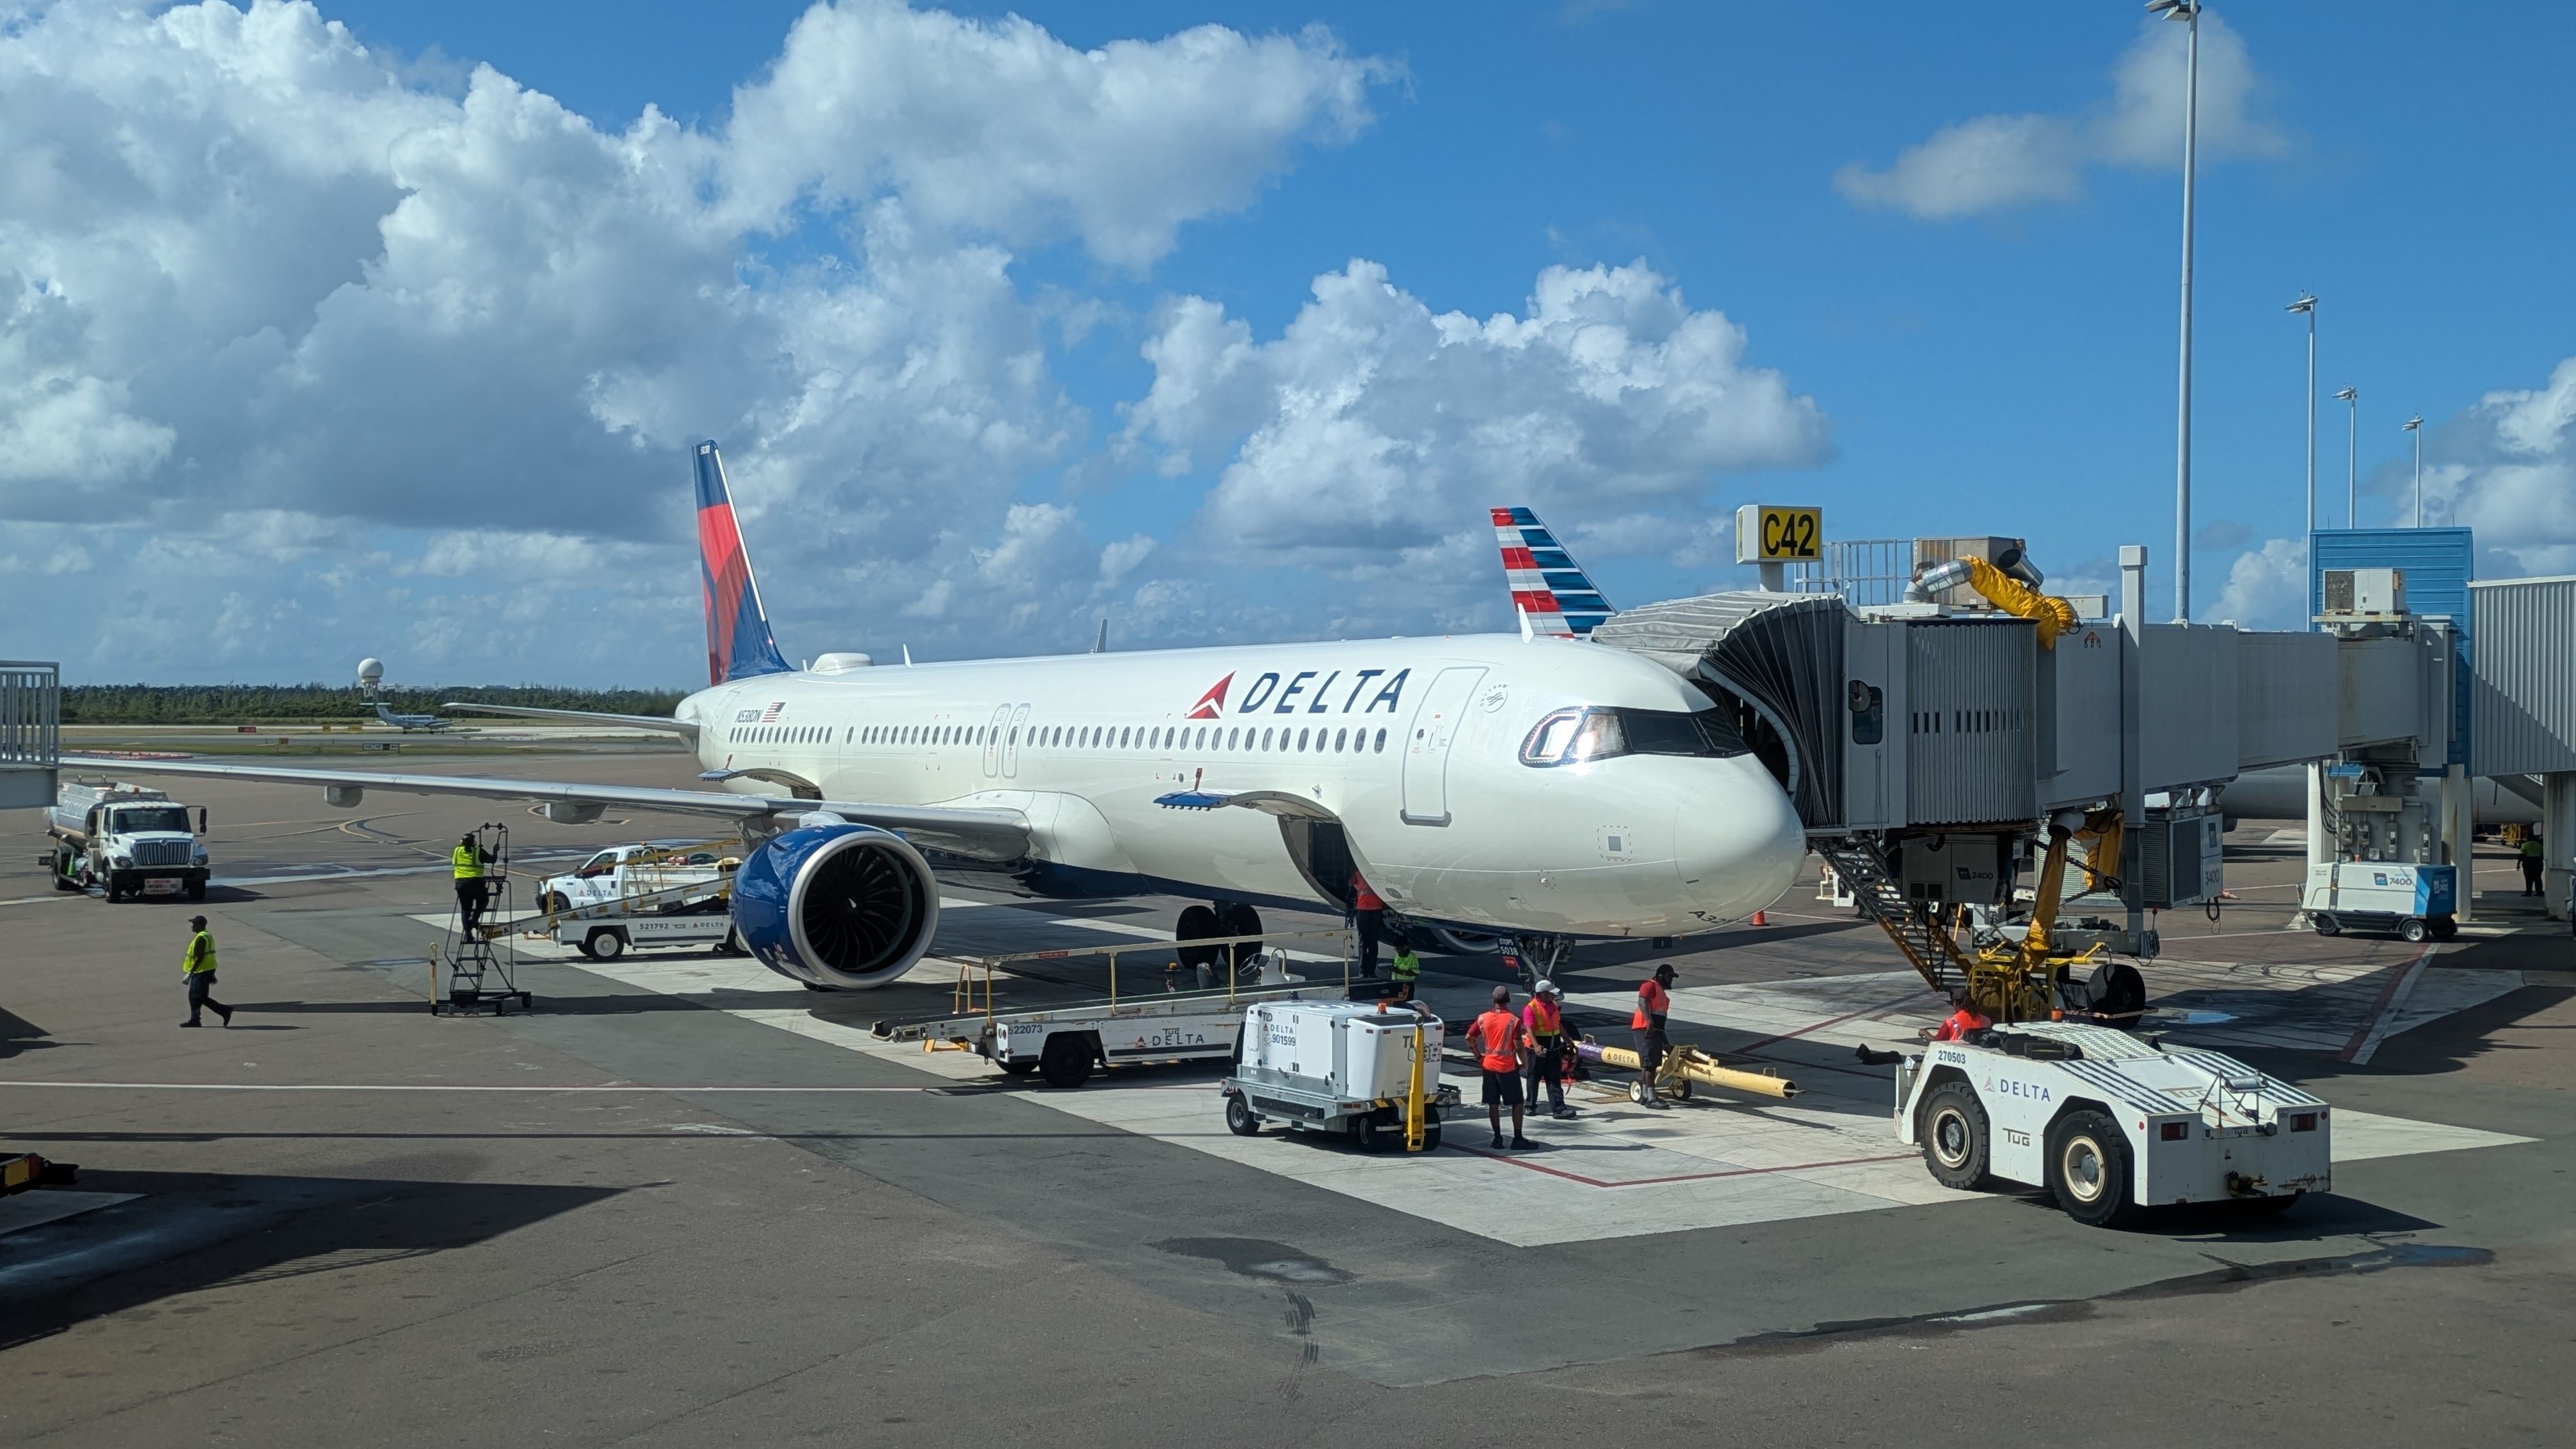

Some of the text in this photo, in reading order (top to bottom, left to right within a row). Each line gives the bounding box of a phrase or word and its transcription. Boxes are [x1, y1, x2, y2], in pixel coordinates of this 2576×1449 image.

[1764, 513, 1814, 556] C42
[1238, 668, 1412, 714] DELTA
[1972, 871, 1994, 880] 2400
[2389, 877, 2412, 886] 7400
[1499, 946, 1519, 956] 5038
[1262, 1011, 1273, 1022] TLD
[1008, 1024, 1043, 1035] 522073
[1270, 1023, 1294, 1035] DELTA
[1153, 1034, 1205, 1046] DELTA
[1272, 1033, 1296, 1046] 901599
[1402, 1034, 1416, 1048] TL
[1613, 1053, 1636, 1064] DELTA
[1938, 1050, 1966, 1065] 270503
[2000, 1078, 2051, 1103] DELTA
